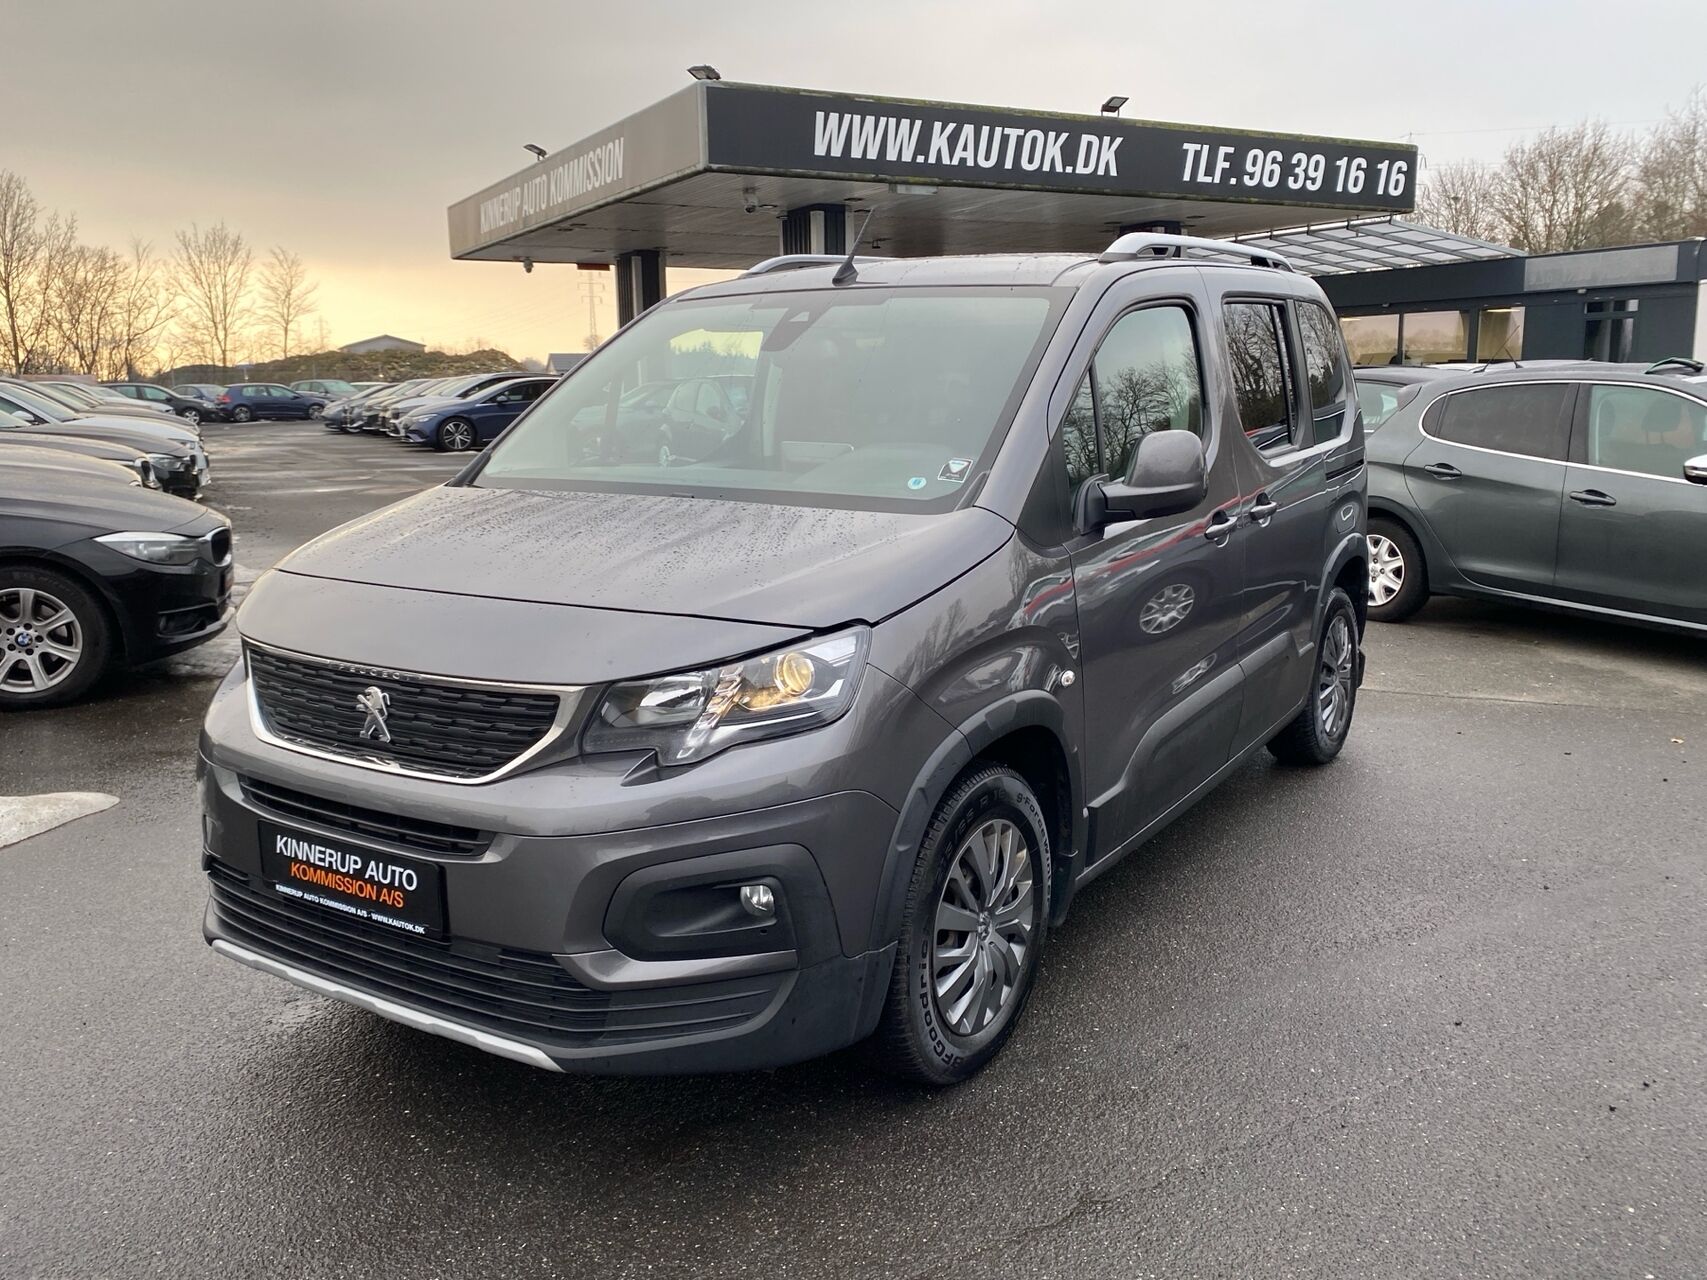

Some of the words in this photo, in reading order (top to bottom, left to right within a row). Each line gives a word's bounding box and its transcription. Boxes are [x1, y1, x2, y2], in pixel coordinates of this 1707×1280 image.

[814, 111, 1123, 177] WWW.KAUTOK.DK
[1182, 142, 1237, 185] TLF.
[1243, 148, 1284, 188] 96
[1288, 152, 1326, 191] 39
[1335, 156, 1368, 194] 16
[1377, 160, 1408, 197] 16
[480, 186, 521, 235] KINNERUP
[522, 174, 548, 218] AUTO
[549, 137, 625, 207] KOMMISSION
[276, 834, 362, 876] KINNERUP
[365, 859, 418, 892] AUTO
[290, 861, 378, 902] KOMMISSION
[379, 887, 405, 909] A/S
[303, 892, 319, 903] AUTO
[357, 908, 367, 918] A/S
